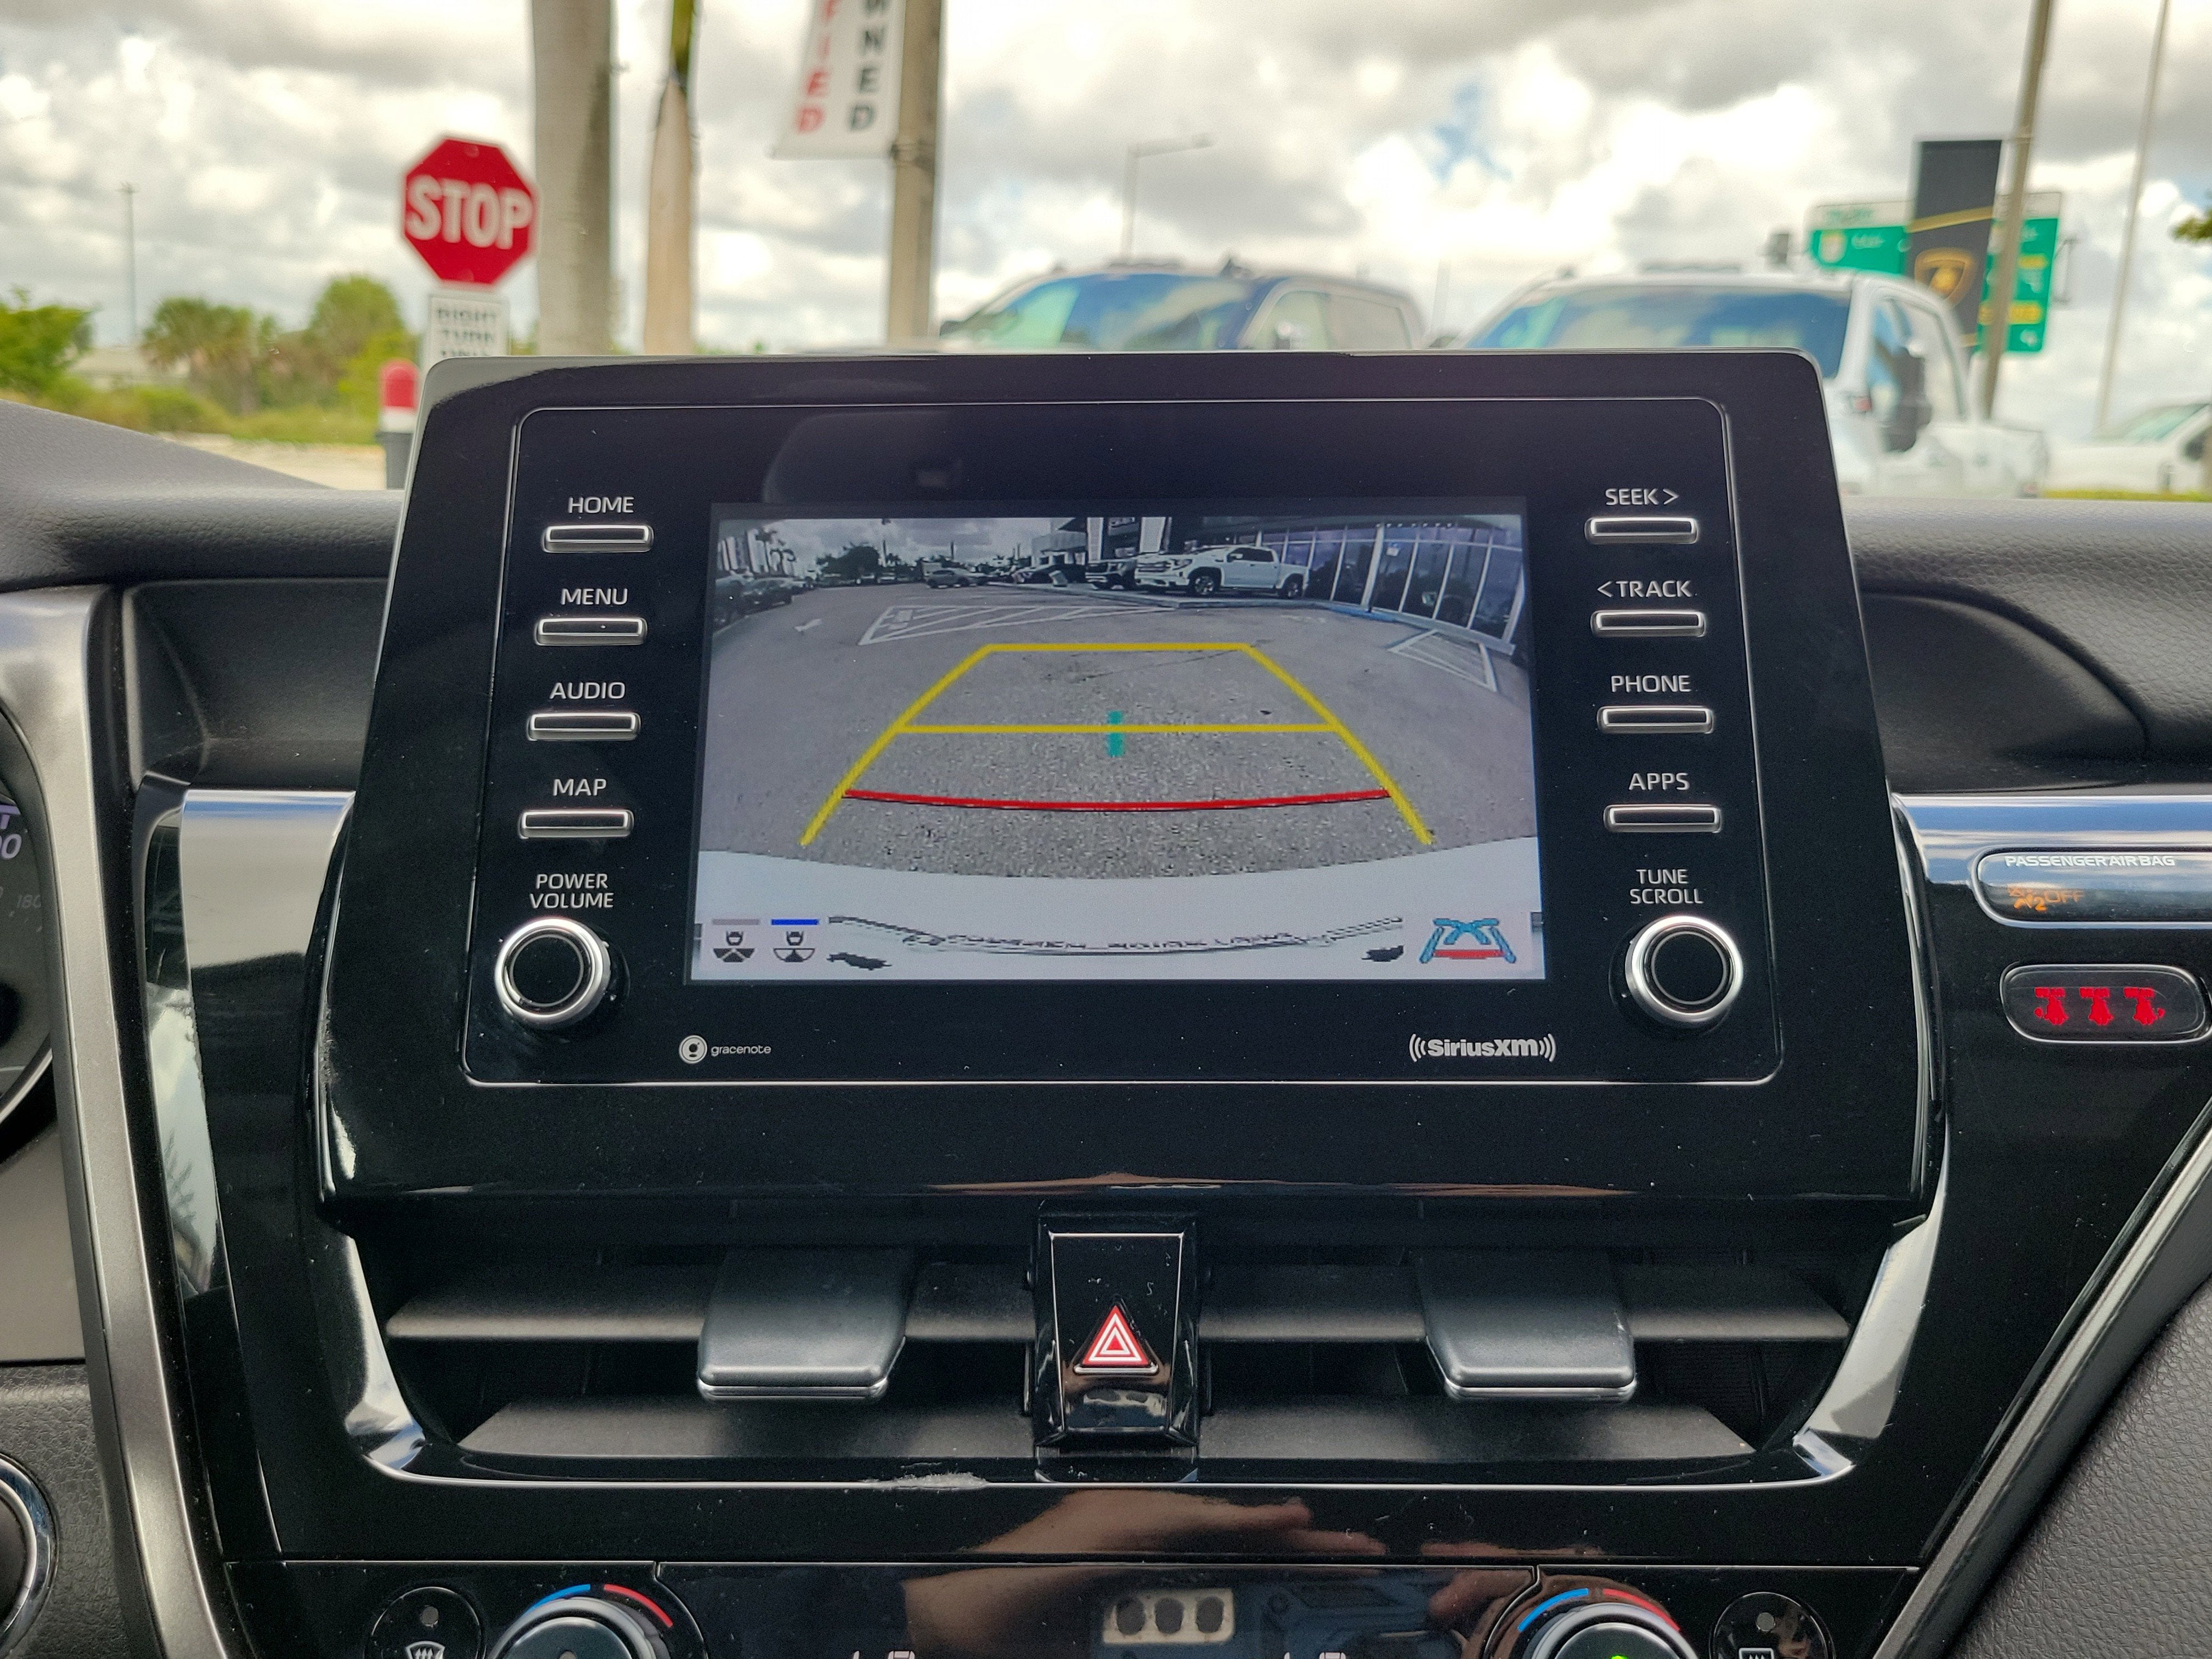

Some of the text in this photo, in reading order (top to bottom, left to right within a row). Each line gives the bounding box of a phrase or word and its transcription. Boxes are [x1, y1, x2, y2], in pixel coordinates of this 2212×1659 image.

[406, 174, 533, 250] STOP
[567, 496, 635, 514] HOME
[560, 588, 628, 605] MENU
[549, 681, 626, 699] AUDIO
[1611, 675, 1692, 693] PHONE
[552, 778, 607, 796] MAP
[1628, 772, 1690, 791] APPS
[2004, 855, 2176, 867] PASSENGER AIR BAG
[535, 873, 608, 889] POWER
[1635, 869, 1689, 884] TUNE
[529, 893, 614, 909] VOLUME
[1629, 888, 1704, 905] SCROLL
[710, 1045, 771, 1057] gracenote
[1427, 1039, 1539, 1057] SiriusXM
